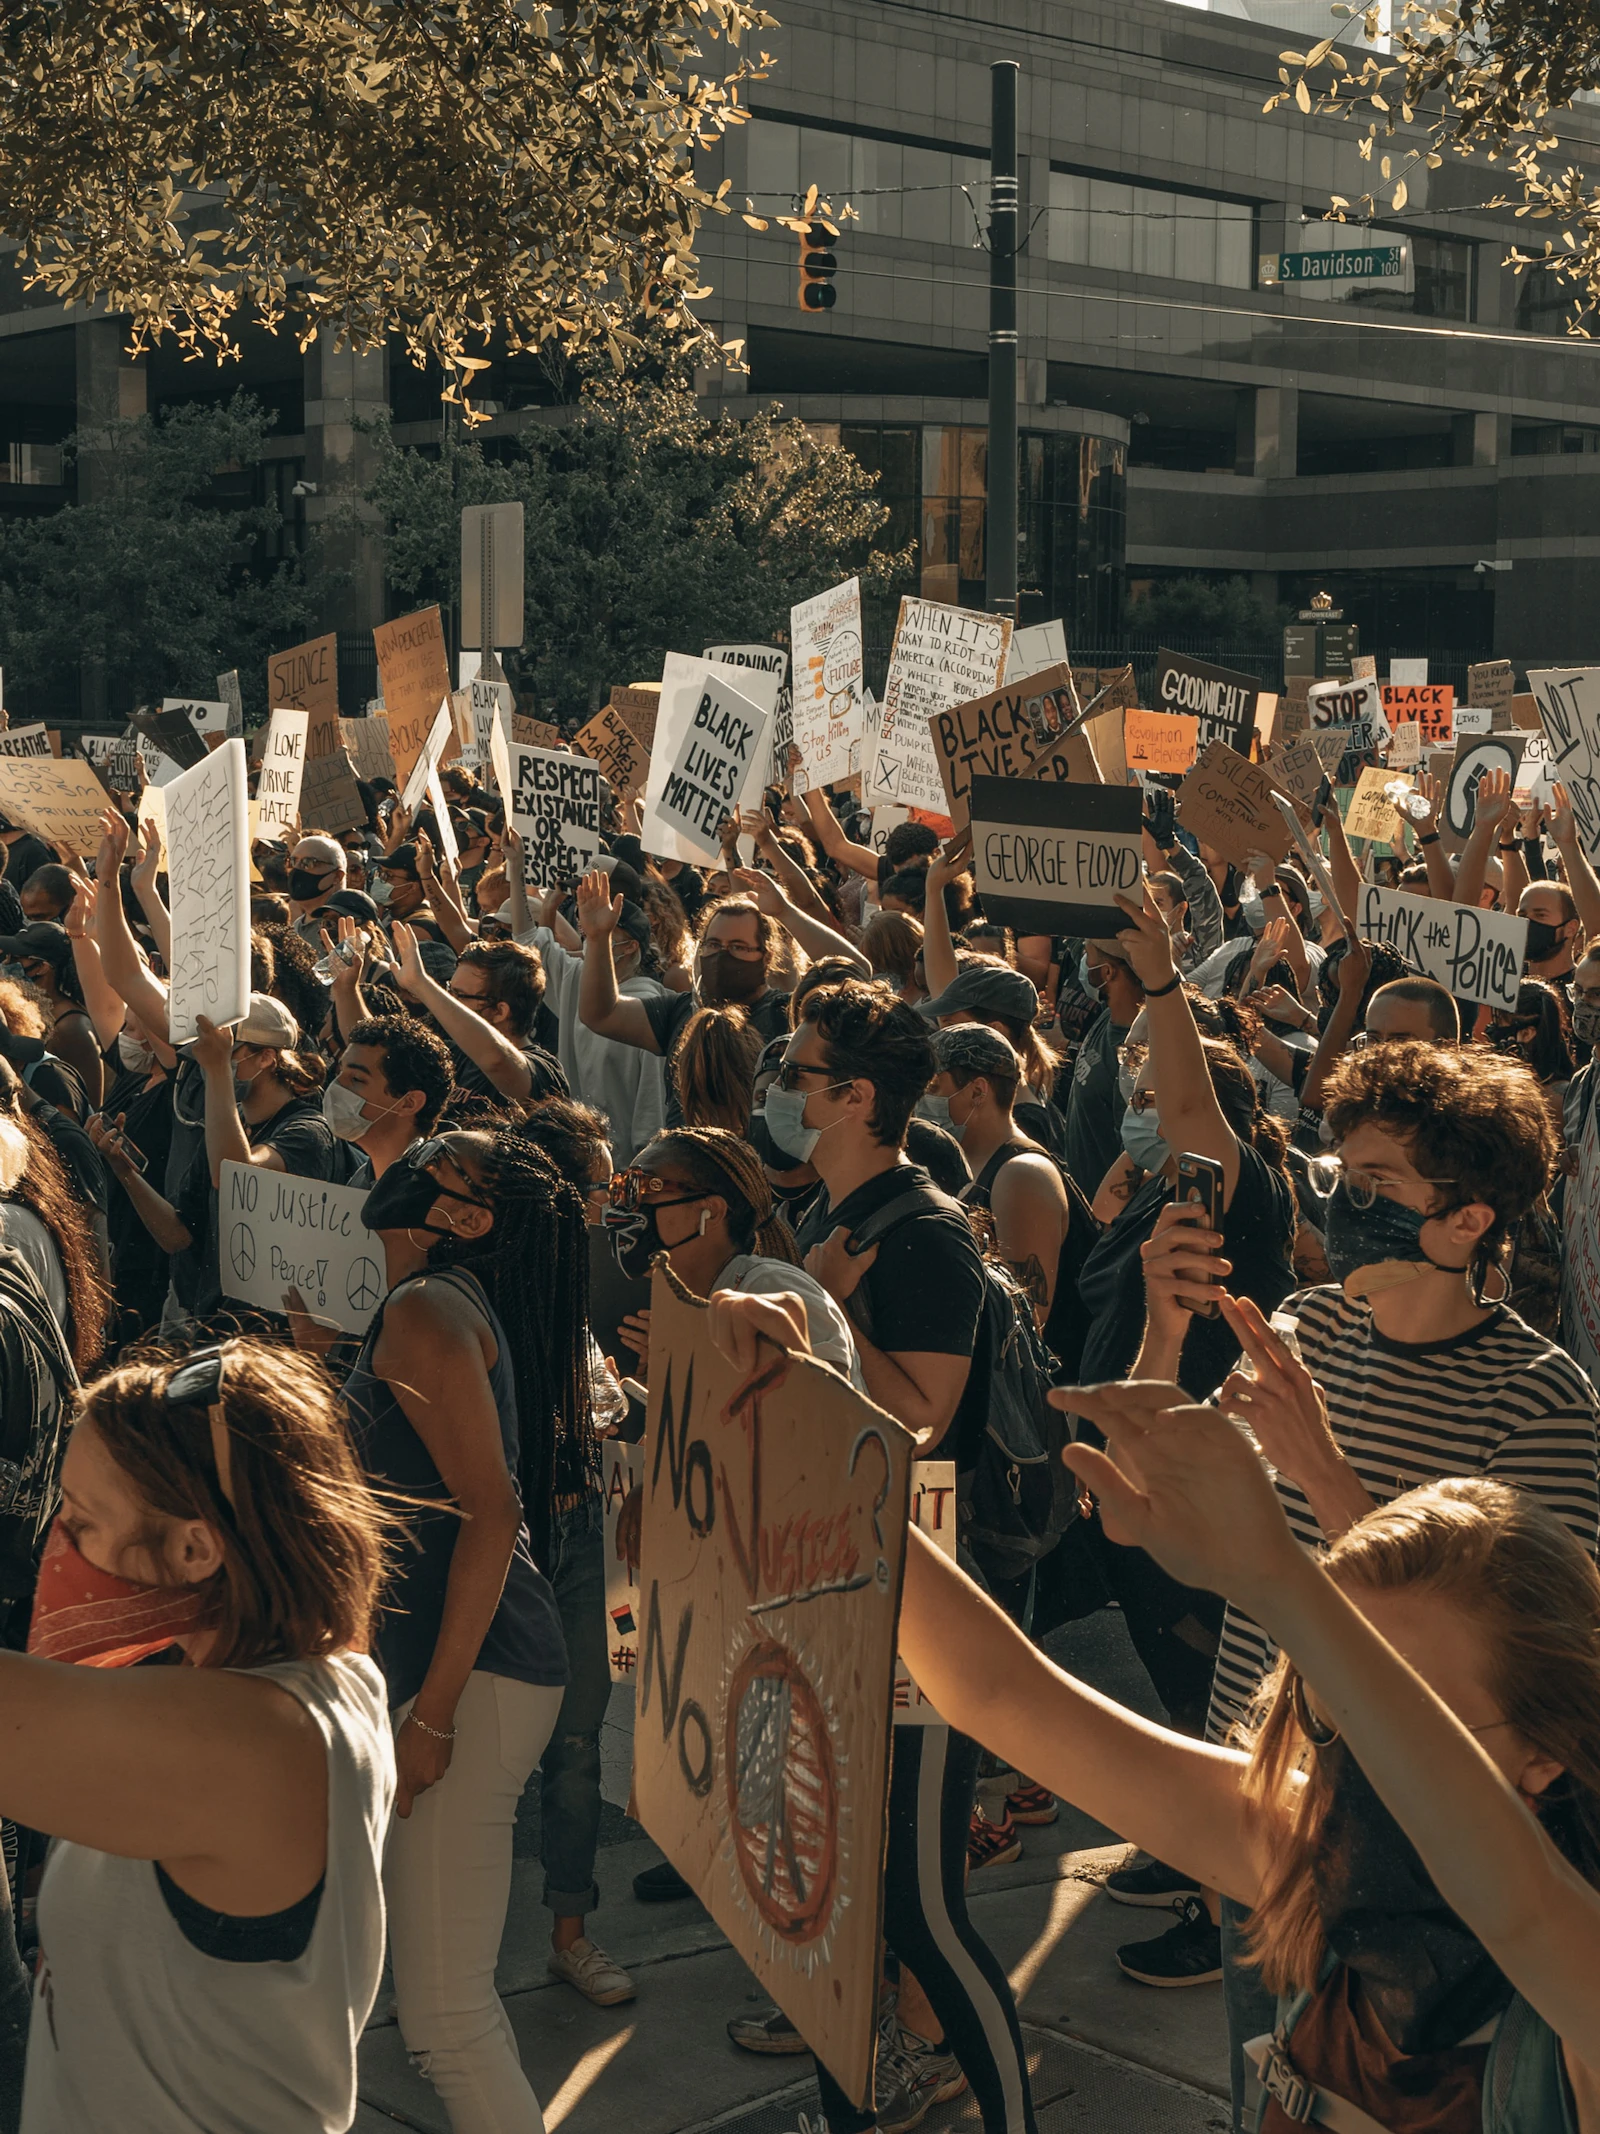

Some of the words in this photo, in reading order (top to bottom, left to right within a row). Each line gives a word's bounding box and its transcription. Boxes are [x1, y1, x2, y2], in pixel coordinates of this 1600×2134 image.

[1282, 259, 1295, 278] S.
[1302, 253, 1373, 277] Davidson
[1381, 262, 1399, 275] 100
[1389, 248, 1399, 261] St
[378, 625, 399, 667] HOW
[399, 619, 440, 654] PEACEFUL
[905, 605, 952, 636] WHEN
[957, 617, 1000, 651] IT'S
[894, 648, 935, 668] AMERICA
[939, 656, 996, 686] (ACCORDING
[898, 630, 923, 648] OKAY
[930, 636, 942, 650] TO
[944, 641, 975, 662] RIOT
[981, 654, 998, 670] IN
[830, 657, 861, 686] FUTURE
[893, 664, 903, 675] TO
[908, 668, 945, 687] WHITE
[640, 693, 660, 707] LIVE
[1161, 668, 1250, 724] GOODNIGHT
[1313, 688, 1368, 728] STOP
[1384, 687, 1443, 705] BLACK
[477, 715, 494, 734] LIV
[512, 716, 553, 742] BLACK
[602, 712, 636, 753] BLACK
[694, 692, 753, 761] BLACK
[938, 695, 1031, 758] BLACK
[1128, 724, 1182, 743] Revolution
[1384, 709, 1443, 723] LIVES
[1422, 726, 1451, 739] TER
[1456, 713, 1480, 725] LIVES
[275, 732, 302, 760] LOVE
[391, 718, 425, 753] YOUR
[802, 729, 825, 764] Stop
[0, 763, 65, 783] ESS
[580, 728, 630, 792] MATTER
[607, 738, 639, 774] LIVES
[684, 741, 738, 800] LIVES
[907, 754, 933, 774] WHEN
[948, 733, 1035, 799] LIVES
[1272, 748, 1313, 778] NEED
[262, 768, 295, 794] DRIVE
[518, 754, 599, 802] RESPECT
[902, 767, 925, 784] BLACK
[926, 777, 944, 788] PERS
[1287, 774, 1304, 794] DO
[32, 806, 104, 816] PRIVILEG
[213, 766, 232, 855] THE
[259, 799, 292, 823] HATE
[302, 781, 334, 811] THE
[512, 789, 599, 833] EXISTANCE
[661, 772, 731, 843] MATTER
[930, 791, 942, 804] BY
[1198, 782, 1270, 832] COMPLIANCE
[198, 770, 217, 893] RACISM
[535, 816, 565, 846] OR
[1215, 806, 1234, 824] WITH
[167, 792, 185, 910] RACISM
[183, 788, 205, 899] DENY
[521, 836, 593, 874] EXPECT
[985, 833, 1068, 886] GEORGE
[1077, 841, 1139, 890] FLOYD
[203, 911, 218, 947] IS
[1424, 922, 1450, 949] the
[1446, 909, 1517, 1003] Police
[203, 953, 218, 1004] TO
[232, 1171, 258, 1213] NO
[651, 1350, 716, 1538] NO
[641, 1578, 713, 1797] NO
